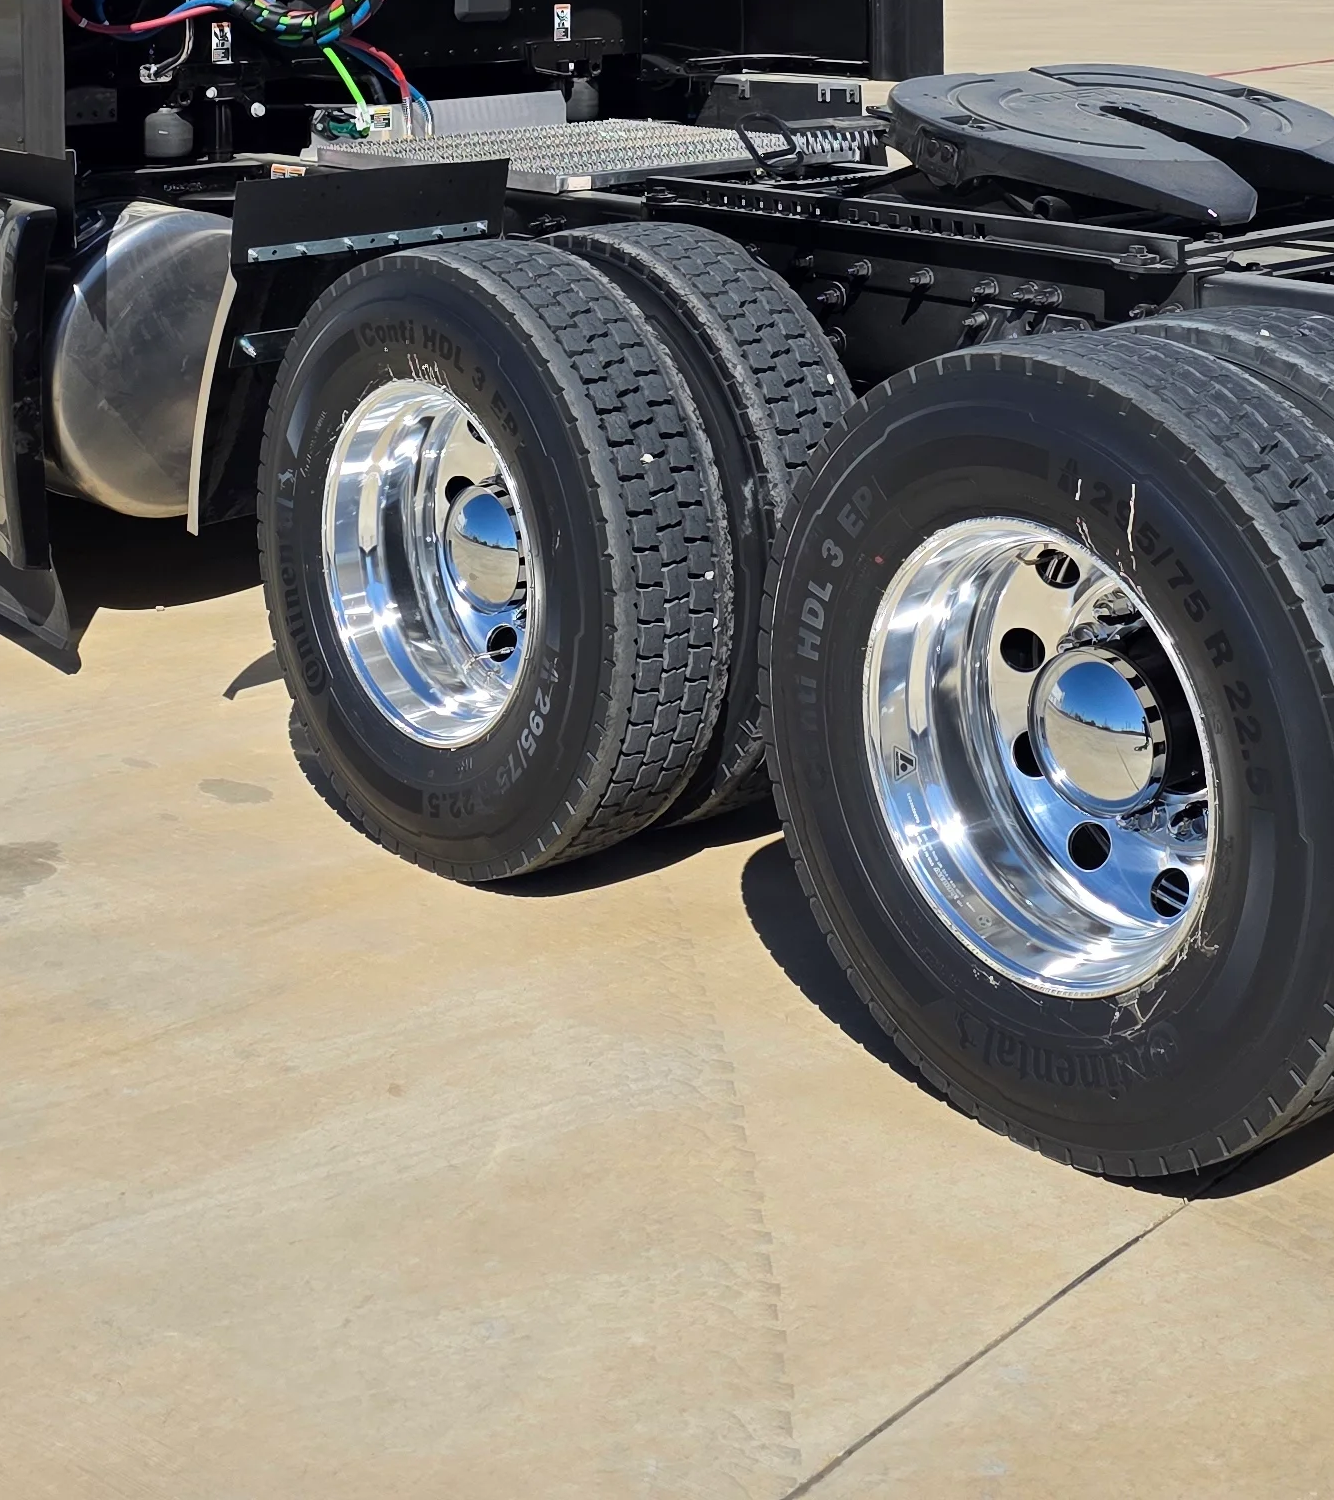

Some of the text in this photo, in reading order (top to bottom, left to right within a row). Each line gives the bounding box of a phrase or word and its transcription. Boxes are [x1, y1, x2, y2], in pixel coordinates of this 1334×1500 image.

[360, 319, 416, 348] Conti
[422, 325, 465, 374] HDL
[472, 367, 486, 392] 3
[796, 579, 834, 662] HDL
[821, 538, 845, 568] 3
[836, 485, 874, 539] EP
[1090, 481, 1276, 797] 295/75 R 22.5
[495, 686, 551, 796] 295/75
[427, 791, 475, 820] 22.5
